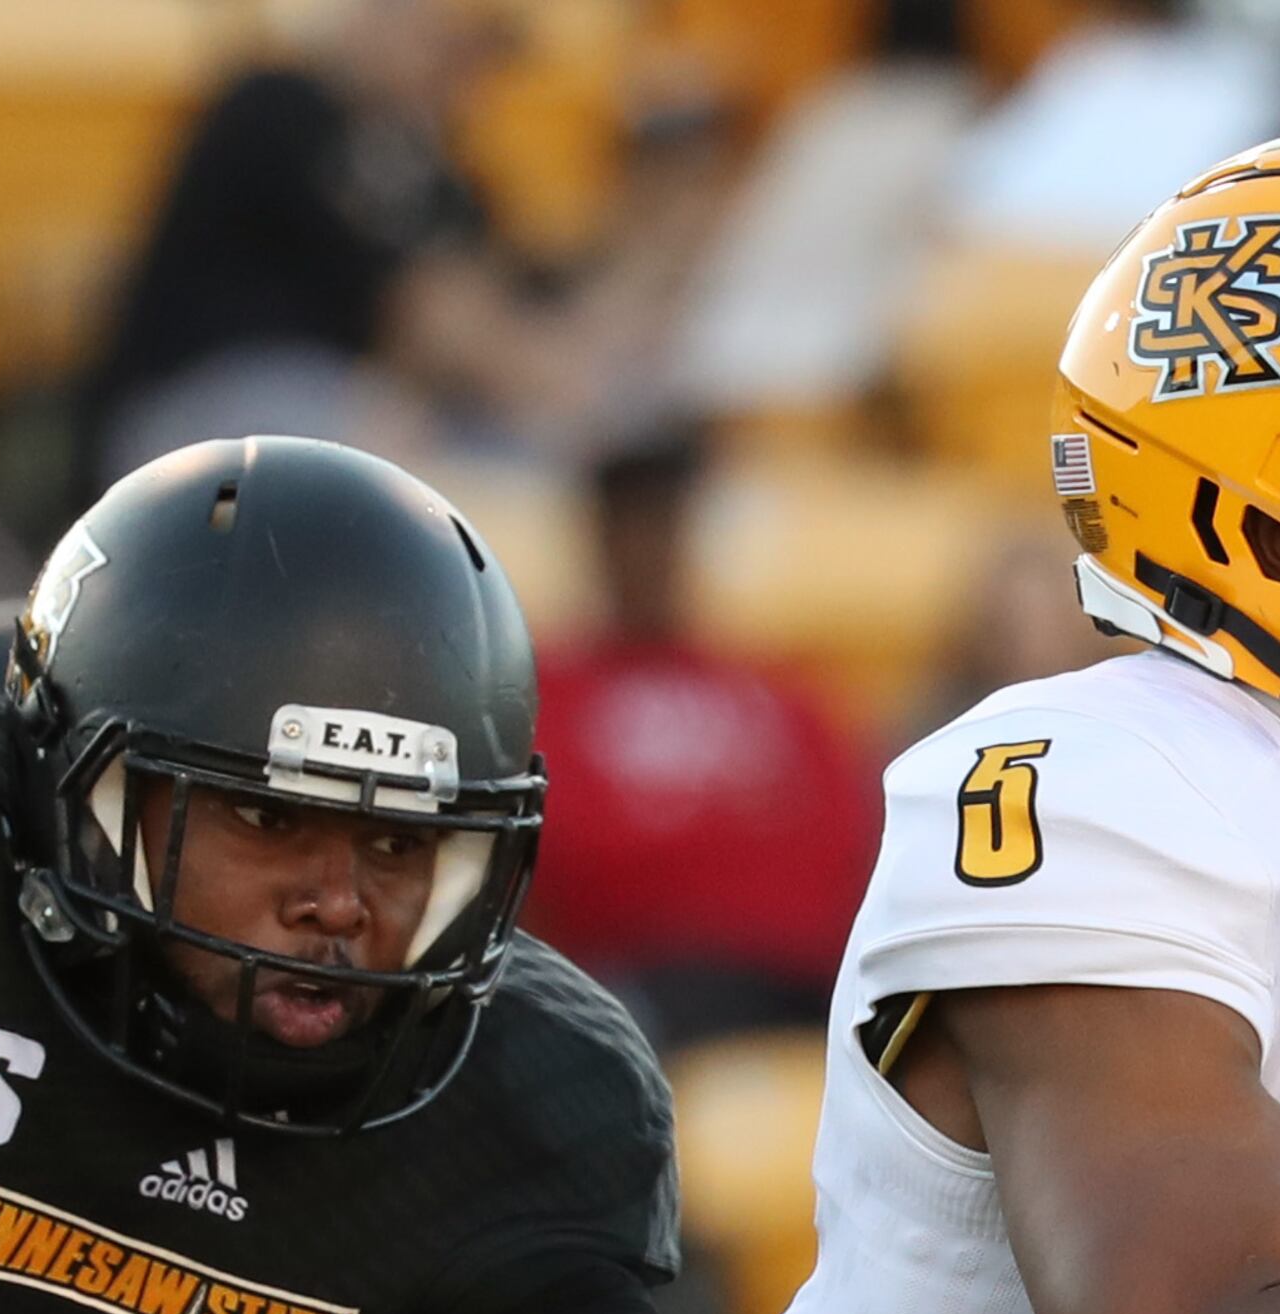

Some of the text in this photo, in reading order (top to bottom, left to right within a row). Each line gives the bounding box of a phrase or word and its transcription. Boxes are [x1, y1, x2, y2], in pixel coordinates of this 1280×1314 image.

[322, 722, 412, 760] E.A.T.
[953, 738, 1053, 888] 5
[139, 1174, 249, 1221] adidas
